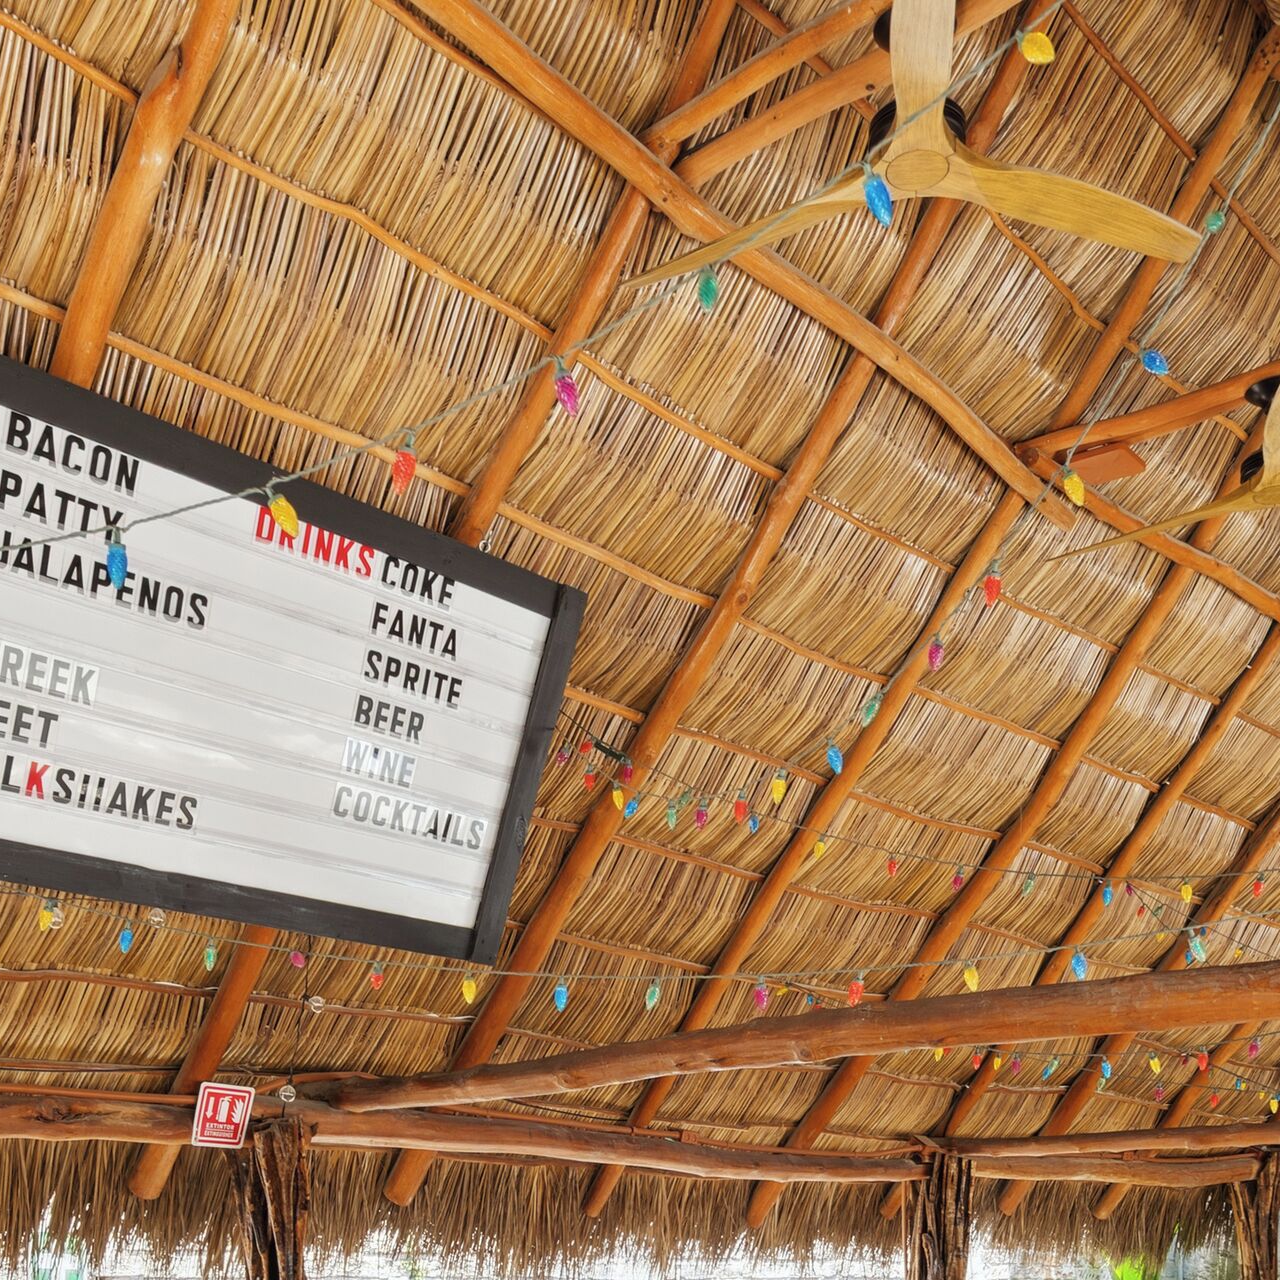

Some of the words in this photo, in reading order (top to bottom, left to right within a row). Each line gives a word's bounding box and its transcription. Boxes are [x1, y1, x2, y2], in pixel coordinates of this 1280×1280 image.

[6, 411, 140, 497] BACON
[380, 555, 456, 611] COKE
[371, 602, 457, 662] FANTA
[364, 649, 463, 710] SPRITE
[354, 694, 425, 745] BEER
[345, 739, 416, 788] WINE
[332, 786, 485, 850] COCKTAILS
